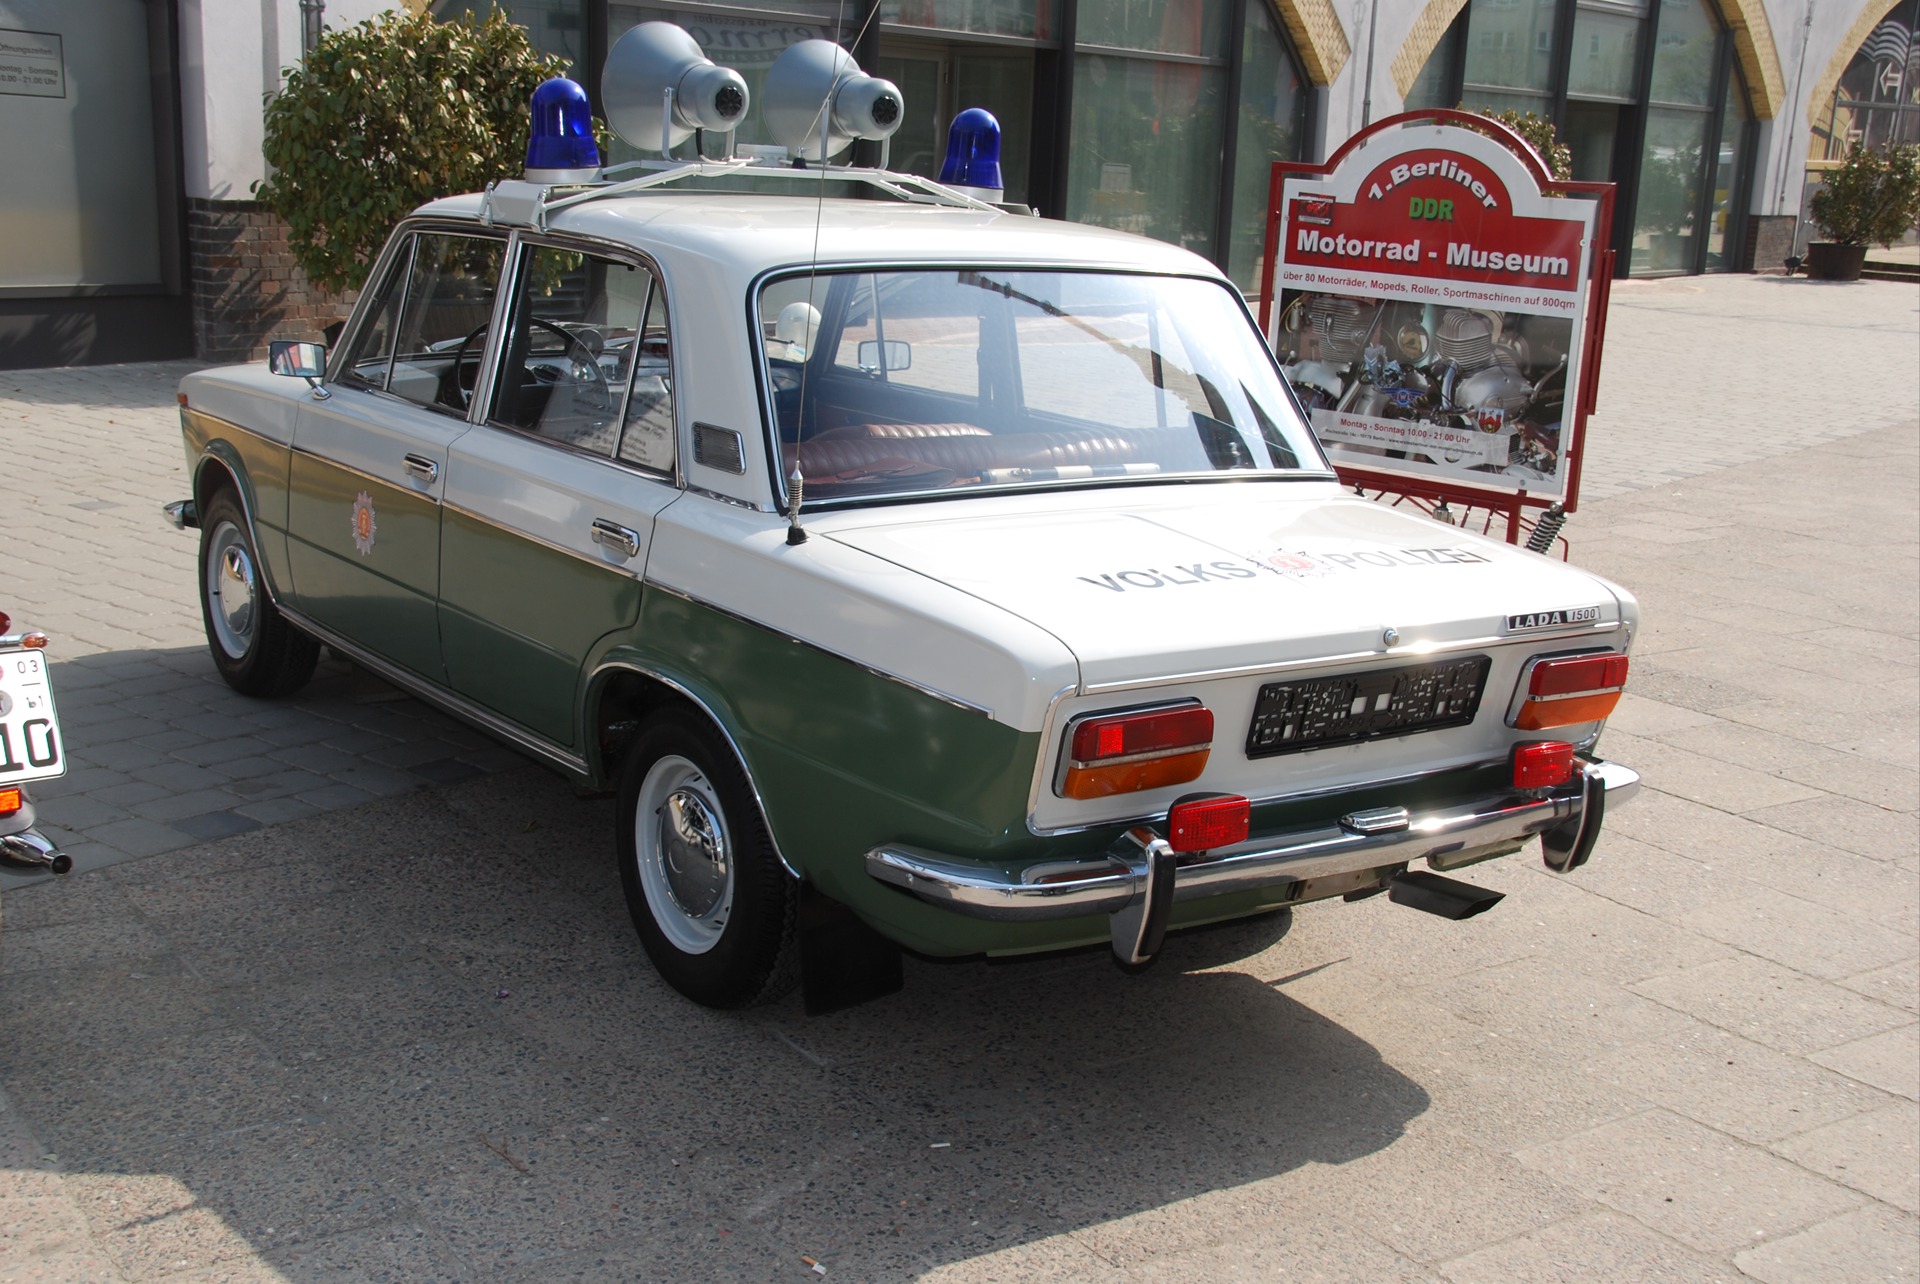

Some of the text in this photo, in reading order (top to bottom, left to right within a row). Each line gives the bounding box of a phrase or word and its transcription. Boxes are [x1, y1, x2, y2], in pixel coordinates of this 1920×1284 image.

[0, 64, 22, 75] ontag
[28, 66, 58, 77] Sonntag
[0, 74, 17, 82] 0.00
[44, 78, 57, 86] Uhr
[1409, 197, 1454, 220] DDR
[1297, 229, 1421, 262] Motorrad
[1446, 242, 1569, 276] Museum
[1283, 271, 1575, 310] über 80 Motorräder, Mopeds, Roller, Sportmaschinen auf 800qm
[1340, 418, 1367, 430] Montag
[1374, 423, 1405, 436] Sonntag
[1408, 428, 1427, 438] 10.00
[1433, 431, 1454, 442] 21.00
[1455, 435, 1470, 444] Uhr
[1076, 548, 1492, 592] VOLKS POLIZEI
[1515, 608, 1596, 629] LADA 1500
[17, 659, 39, 674] 03
